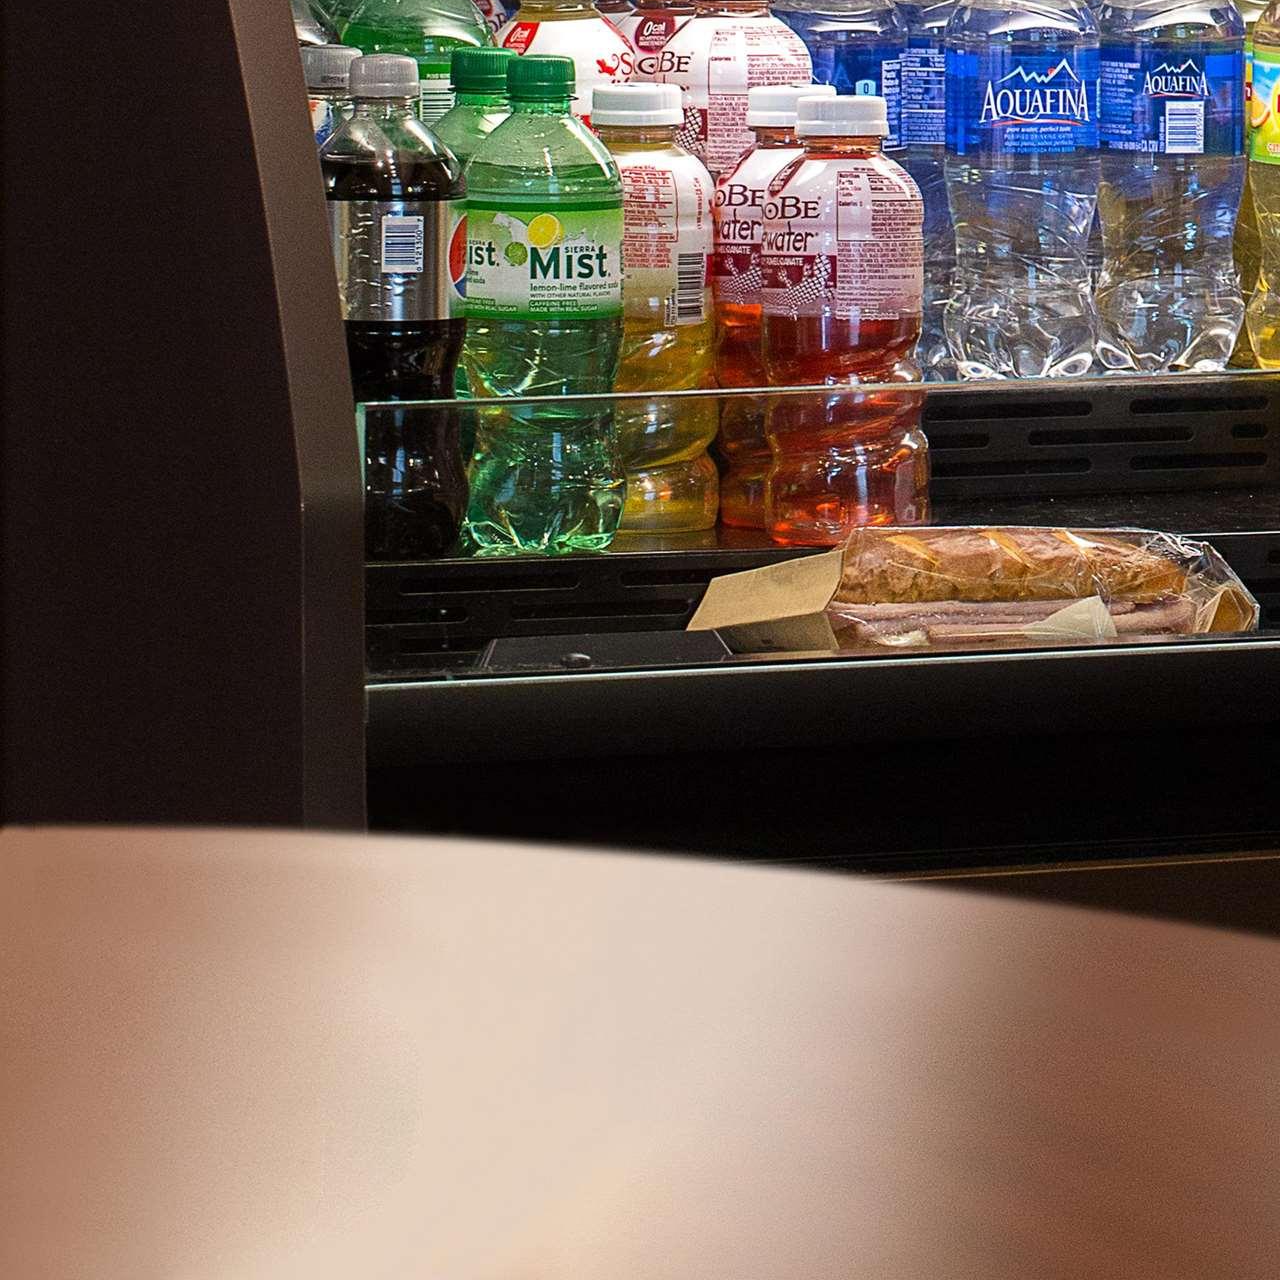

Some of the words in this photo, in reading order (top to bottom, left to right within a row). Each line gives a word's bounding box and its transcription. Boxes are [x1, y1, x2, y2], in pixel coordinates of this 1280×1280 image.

[1142, 71, 1209, 97] AQUAFINA
[979, 79, 1090, 126] AQUAFINA
[469, 241, 496, 267] ist
[529, 244, 608, 280] Mist
[564, 245, 595, 254] SIERRA
[530, 283, 577, 292] lemon-lime
[579, 282, 607, 291] flavored
